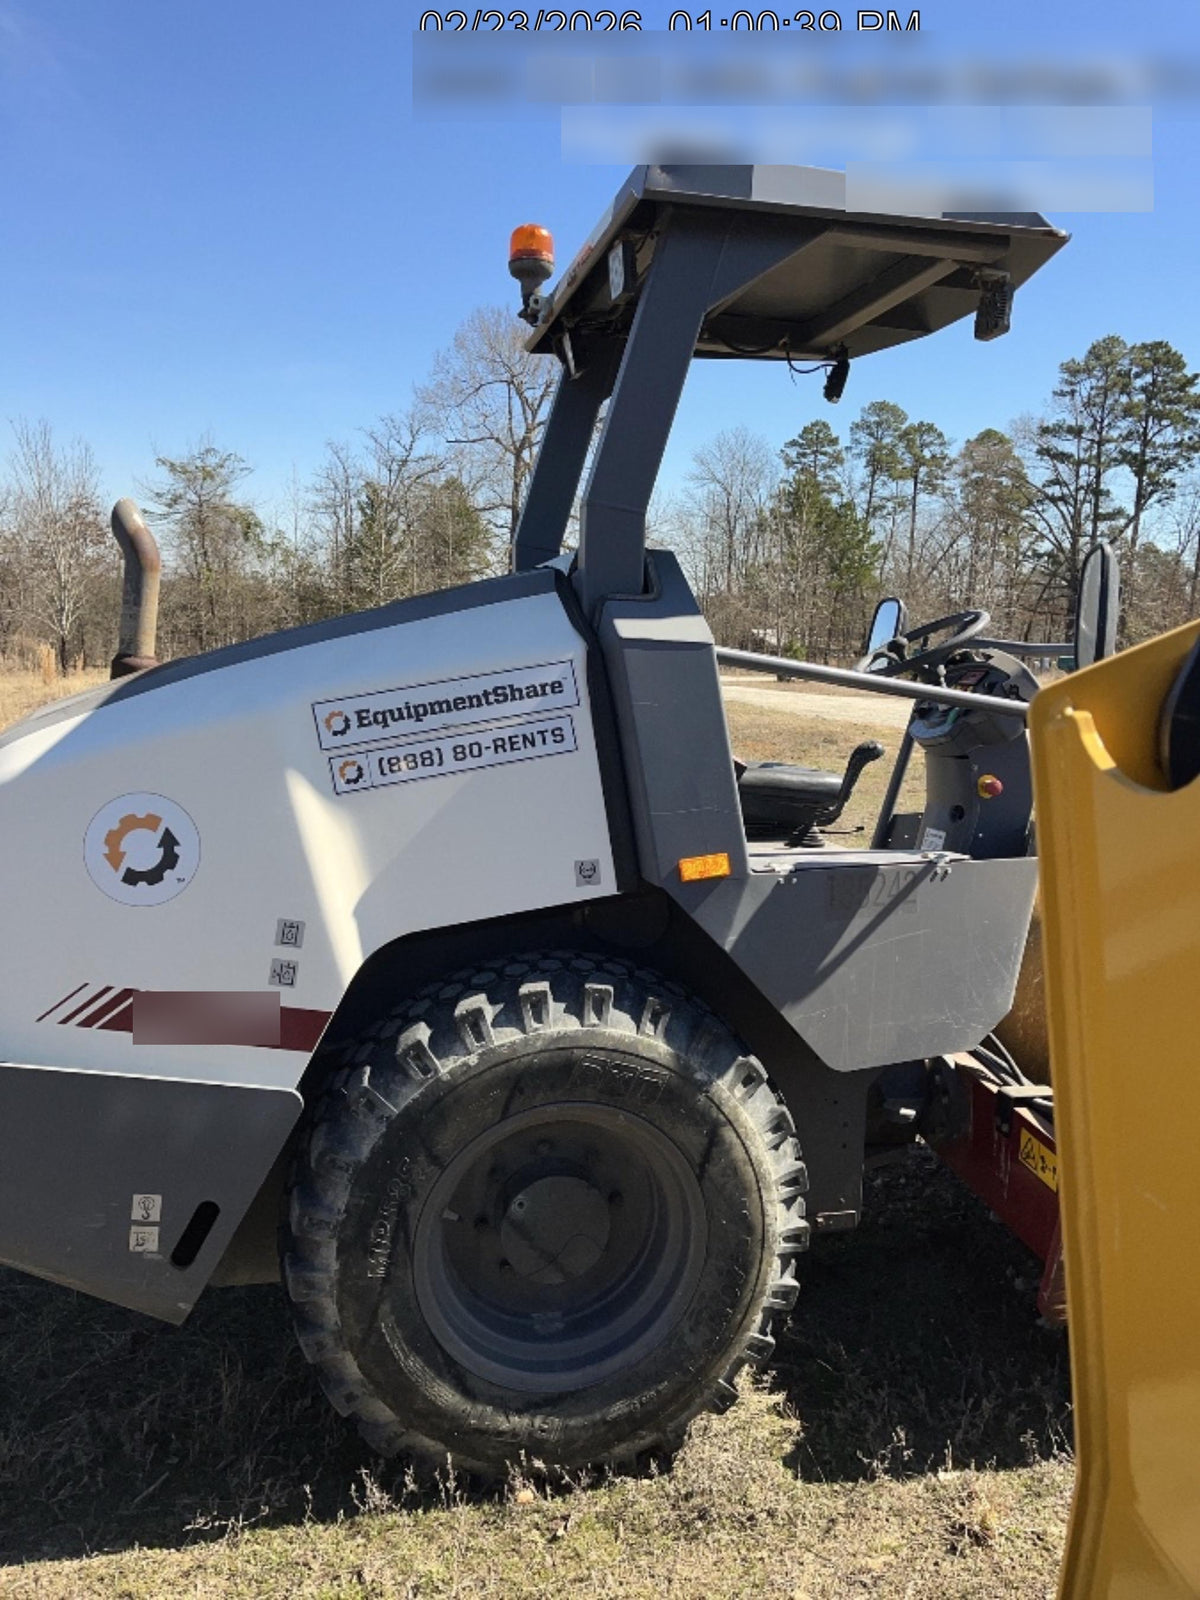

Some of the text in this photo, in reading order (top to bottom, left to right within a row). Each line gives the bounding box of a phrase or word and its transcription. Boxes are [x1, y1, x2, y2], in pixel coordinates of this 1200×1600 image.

[354, 679, 564, 729] EquipmentShare
[378, 726, 565, 776] (888) 80-RENTS
